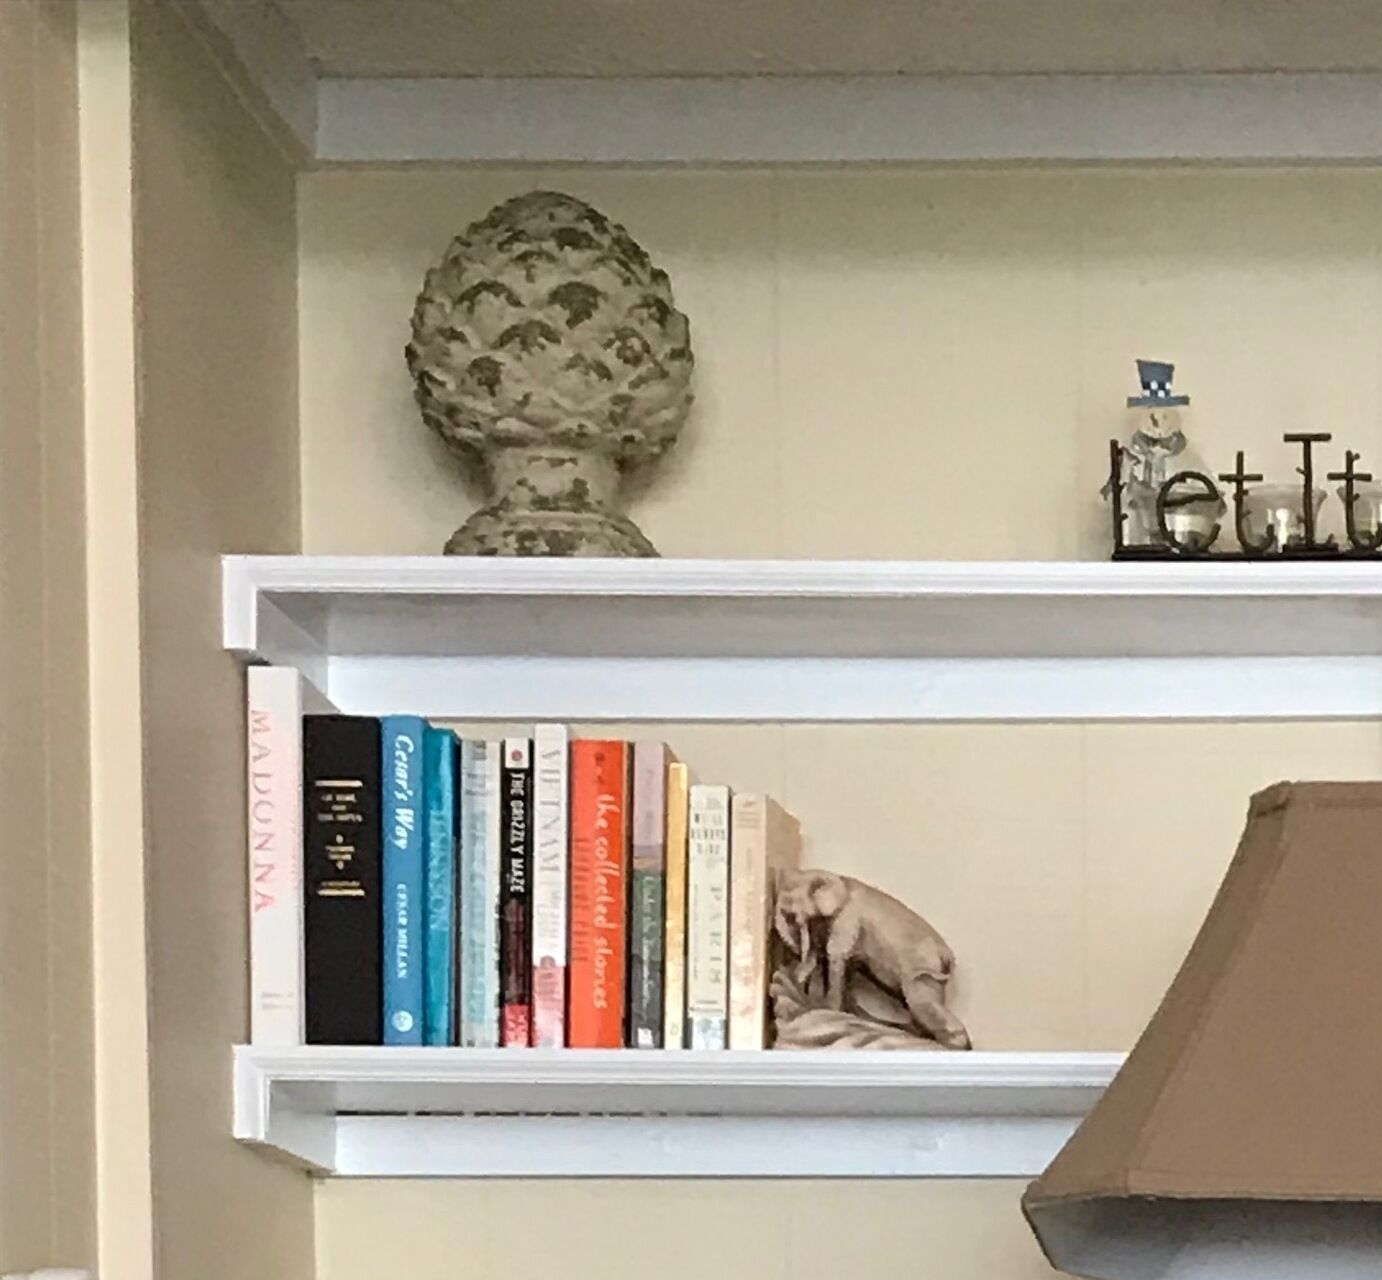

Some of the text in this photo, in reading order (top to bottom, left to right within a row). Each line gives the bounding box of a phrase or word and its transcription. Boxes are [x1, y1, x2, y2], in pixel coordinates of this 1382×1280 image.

[1108, 438, 1276, 553] Let
[250, 709, 276, 912] MADONNA
[389, 734, 415, 851] Cesar's Way
[509, 772, 526, 796] THE
[509, 799, 526, 855] GRIZZLY
[537, 747, 562, 873] VIETNAM
[509, 857, 526, 894] MAZE
[592, 793, 621, 1009] the collected stories
